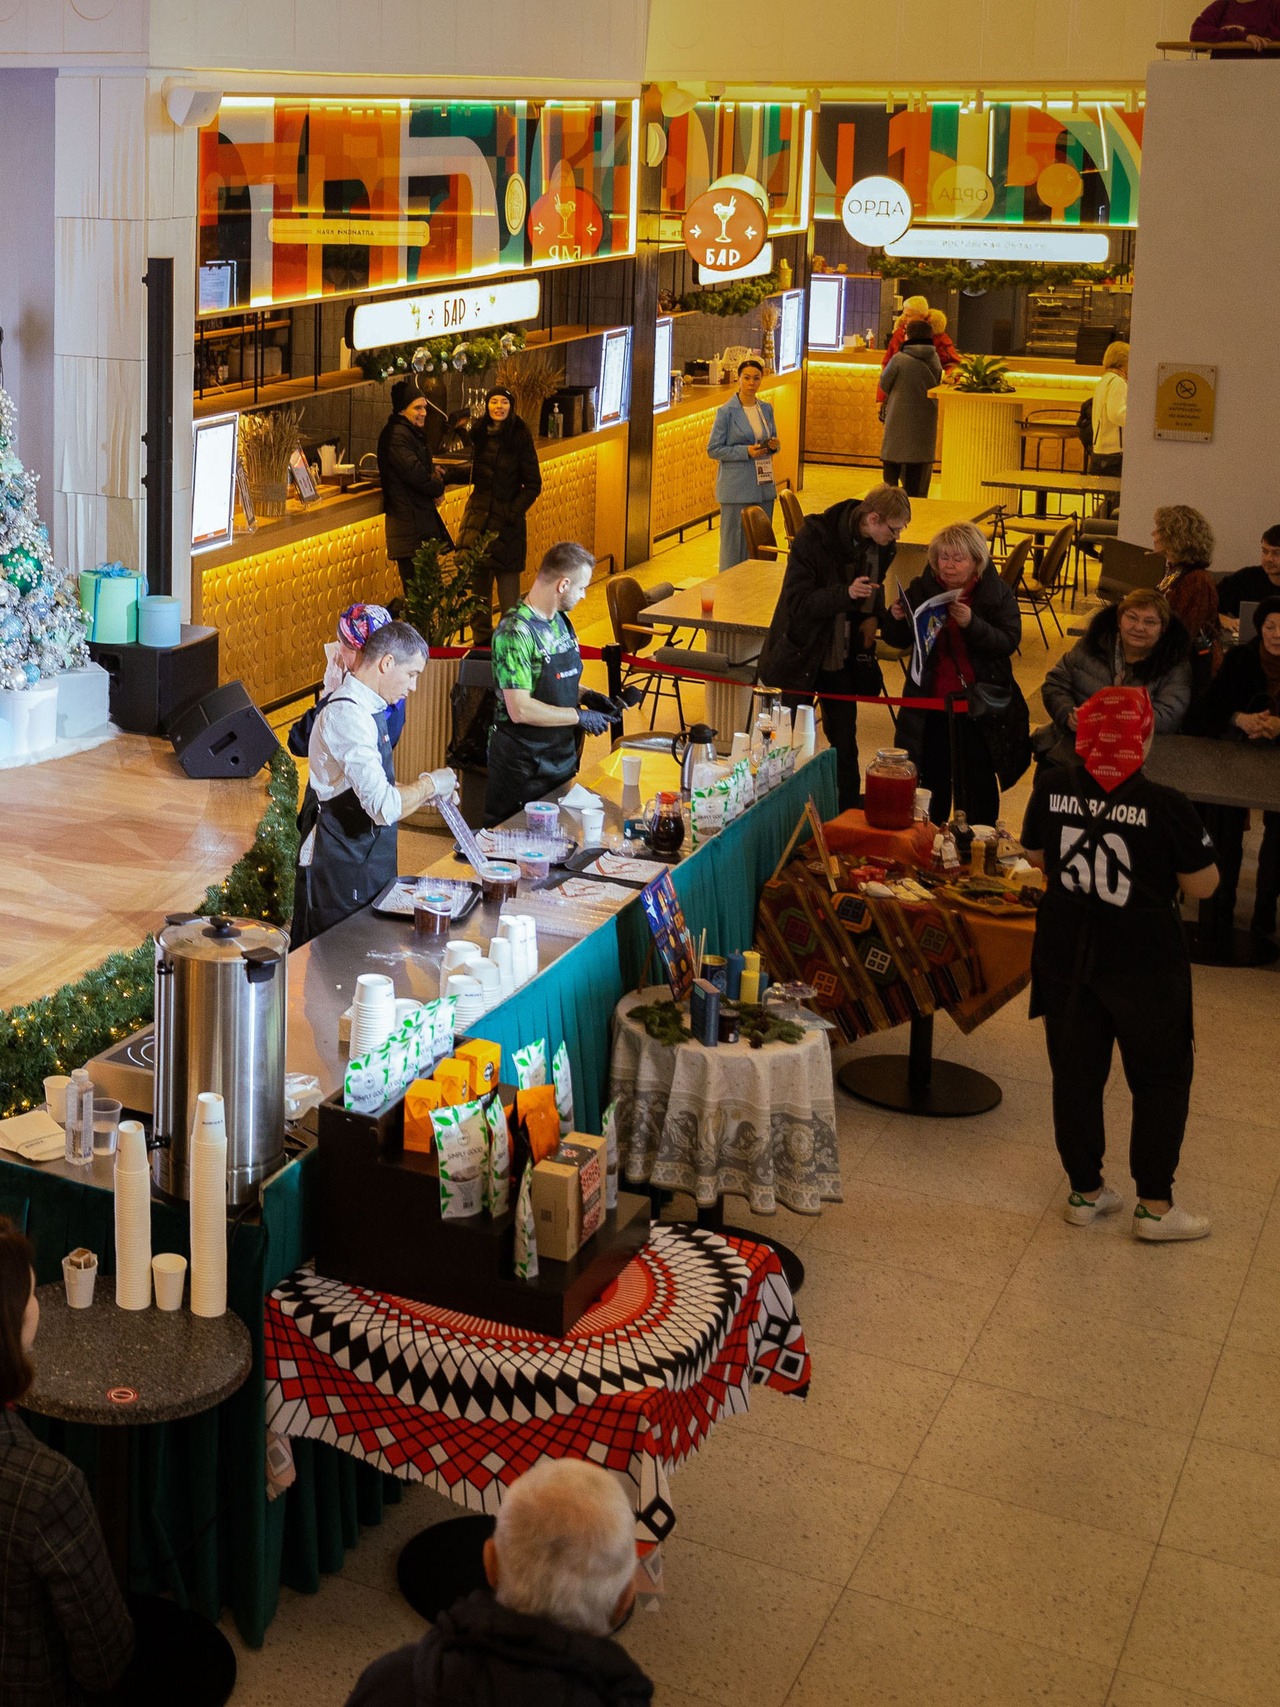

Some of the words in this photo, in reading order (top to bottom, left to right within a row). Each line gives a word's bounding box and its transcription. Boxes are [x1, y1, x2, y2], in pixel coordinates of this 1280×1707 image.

[848, 199, 905, 217] ОРДА
[706, 248, 740, 266] БАР
[443, 298, 466, 327] БАР
[1060, 825, 1131, 908] 50
